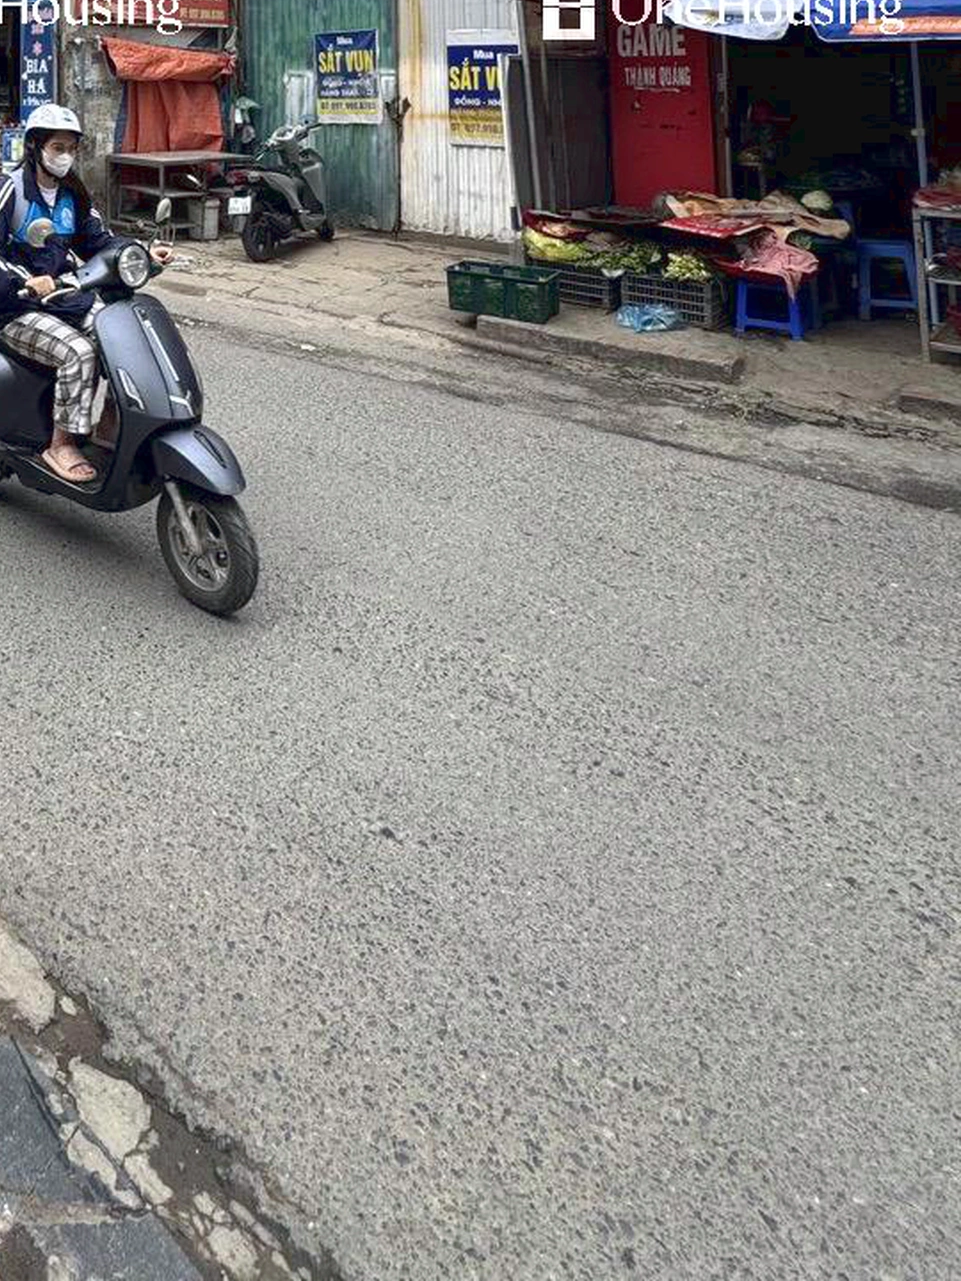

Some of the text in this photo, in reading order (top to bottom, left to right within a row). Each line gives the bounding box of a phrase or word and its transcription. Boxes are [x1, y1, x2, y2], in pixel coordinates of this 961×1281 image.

[473, 49, 495, 60] Mua
[616, 22, 687, 58] GAME
[26, 59, 49, 74] BIA
[318, 43, 375, 77] SẮT VỤN
[449, 57, 481, 91] SẮT
